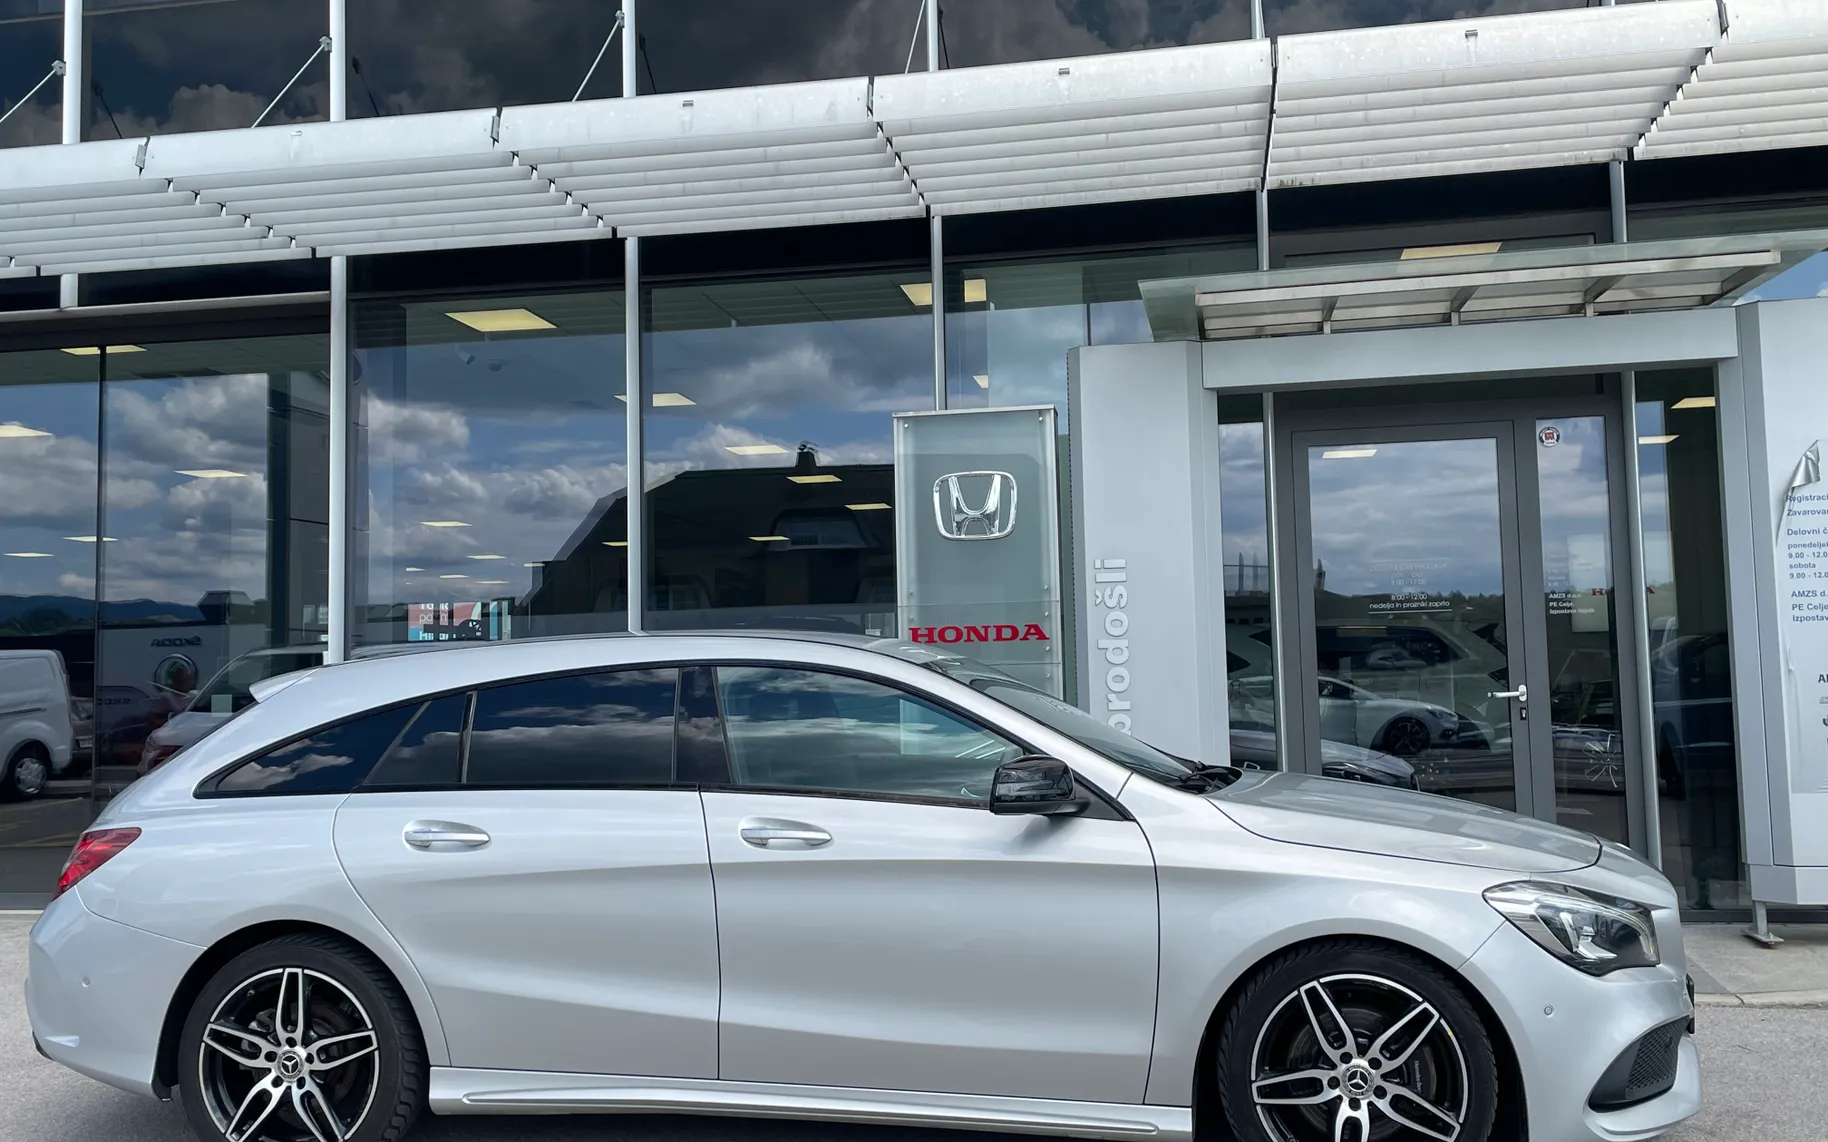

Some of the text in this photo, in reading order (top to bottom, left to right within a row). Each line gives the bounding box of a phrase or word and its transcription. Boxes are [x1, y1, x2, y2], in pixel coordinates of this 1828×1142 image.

[1787, 528, 1820, 536] Delovni
[1791, 590, 1817, 598] AMZS
[1428, 600, 1450, 608] zaprto
[1792, 603, 1804, 611] PE
[908, 623, 1050, 644] HONDA
